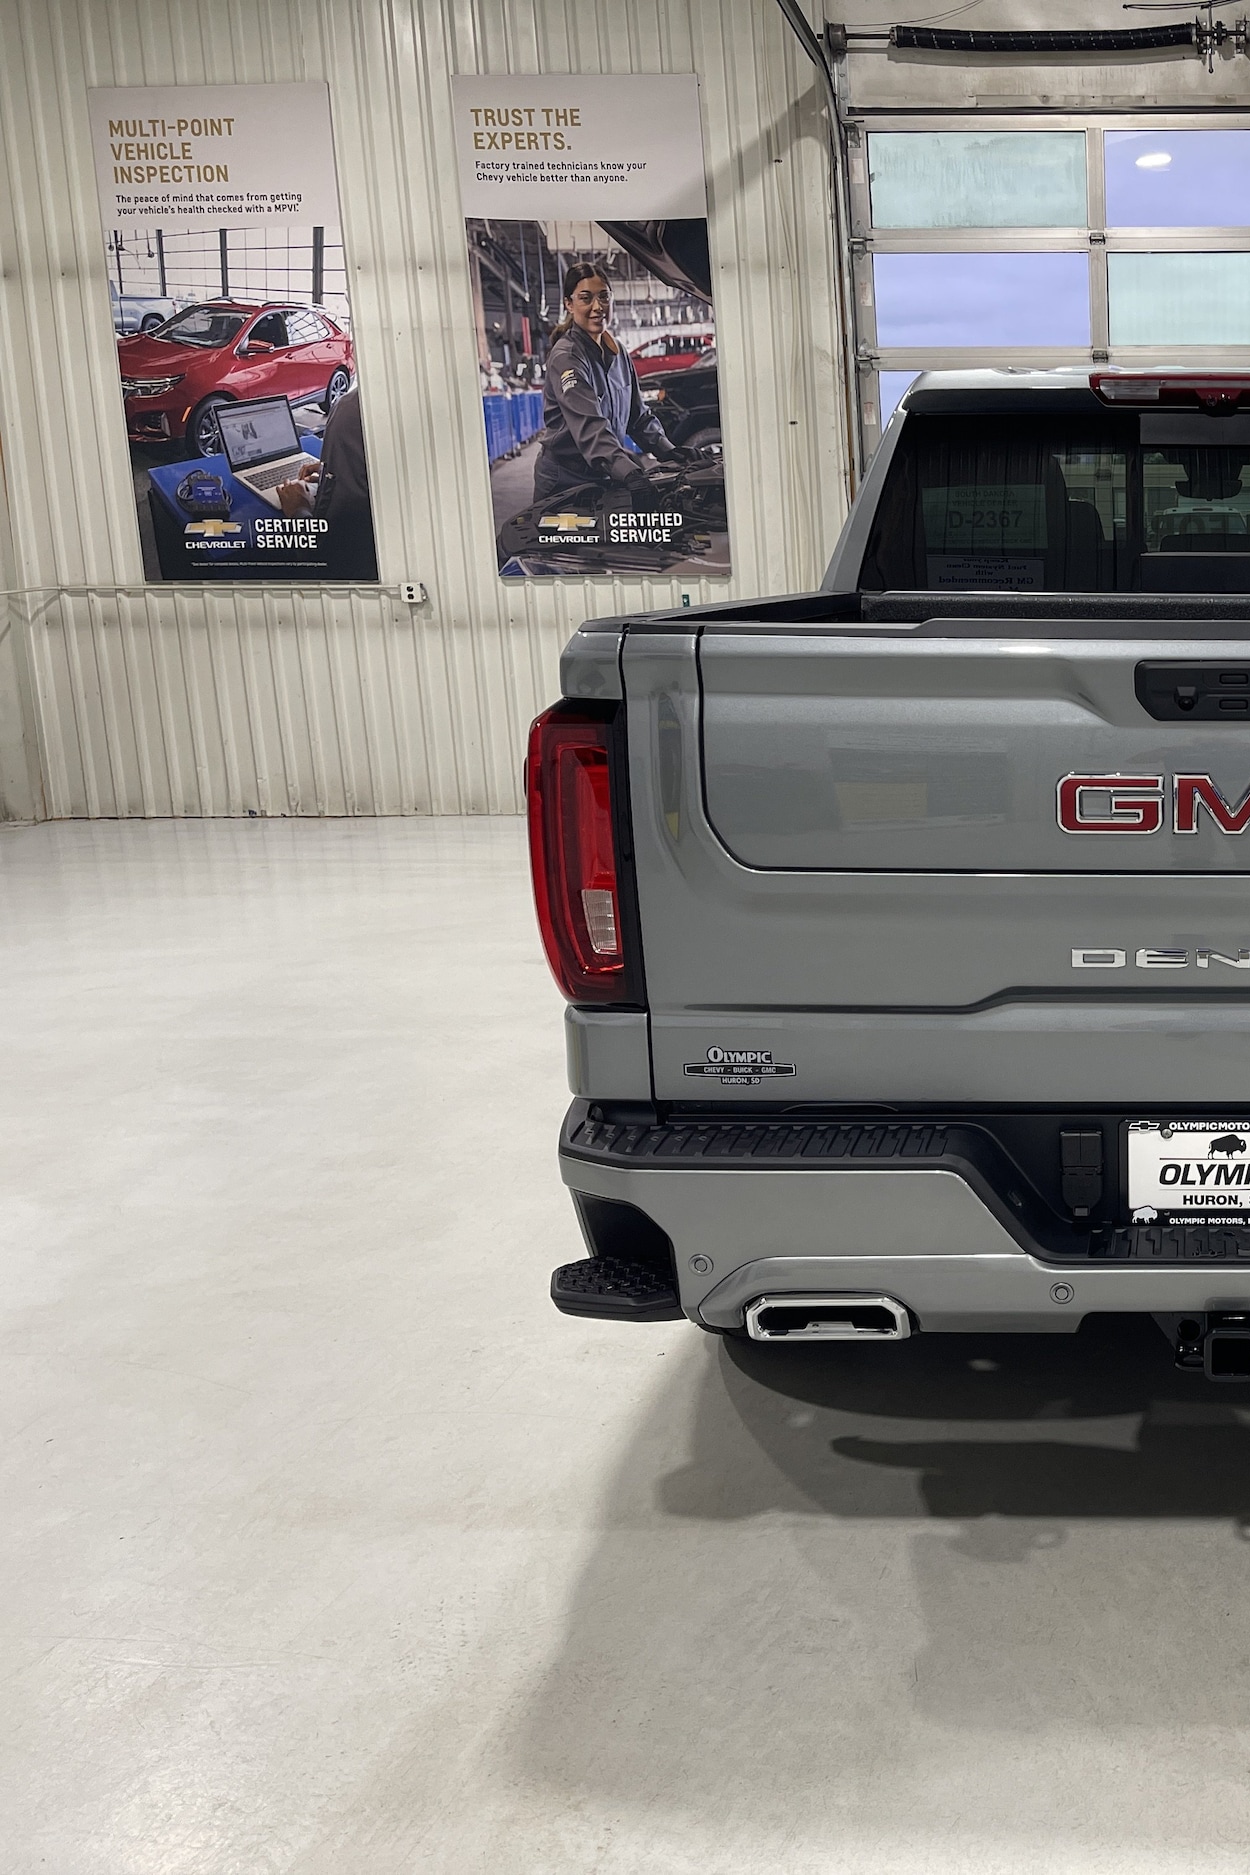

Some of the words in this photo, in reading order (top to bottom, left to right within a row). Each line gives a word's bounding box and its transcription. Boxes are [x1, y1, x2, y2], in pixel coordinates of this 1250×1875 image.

[470, 108, 536, 127] TRUST
[541, 108, 582, 127] THE
[108, 118, 235, 138] MULTI-POINT
[473, 132, 572, 150] EXPERTS.
[110, 142, 193, 161] VEHICLE
[113, 164, 229, 184] INSPECTION
[475, 161, 510, 171] Factory
[512, 161, 545, 170] trained
[547, 161, 598, 170] technicians
[600, 161, 624, 170] know
[626, 162, 647, 172] your
[476, 172, 504, 183] Chevy
[506, 173, 538, 182] vehicle
[540, 173, 568, 182] better
[570, 173, 591, 182] than
[593, 175, 628, 184] anyone.
[115, 195, 132, 203] The
[134, 195, 159, 205] peace
[161, 194, 170, 202] of
[172, 194, 194, 202] mind
[195, 193, 214, 202] that
[216, 194, 244, 202] comes
[246, 193, 268, 201] from
[270, 192, 302, 203] getting
[117, 208, 136, 217] your
[138, 206, 175, 215] vehicle's
[177, 205, 205, 214] health
[207, 205, 243, 213] checked
[245, 204, 265, 213] with
[254, 518, 329, 533] CERTIFIED
[609, 512, 683, 527] CERTIFIED
[948, 510, 1023, 528] D-2367
[256, 534, 318, 549] SERVICE
[538, 535, 600, 544] CHEVROLET
[610, 528, 672, 543] SERVICE
[185, 540, 247, 549] CHEVROLET
[722, 1077, 750, 1085] HURON,
[1182, 1194, 1243, 1208] HURON,
[1169, 1217, 1206, 1225] OLYMPIC
[1207, 1217, 1246, 1226] MOTORS,
